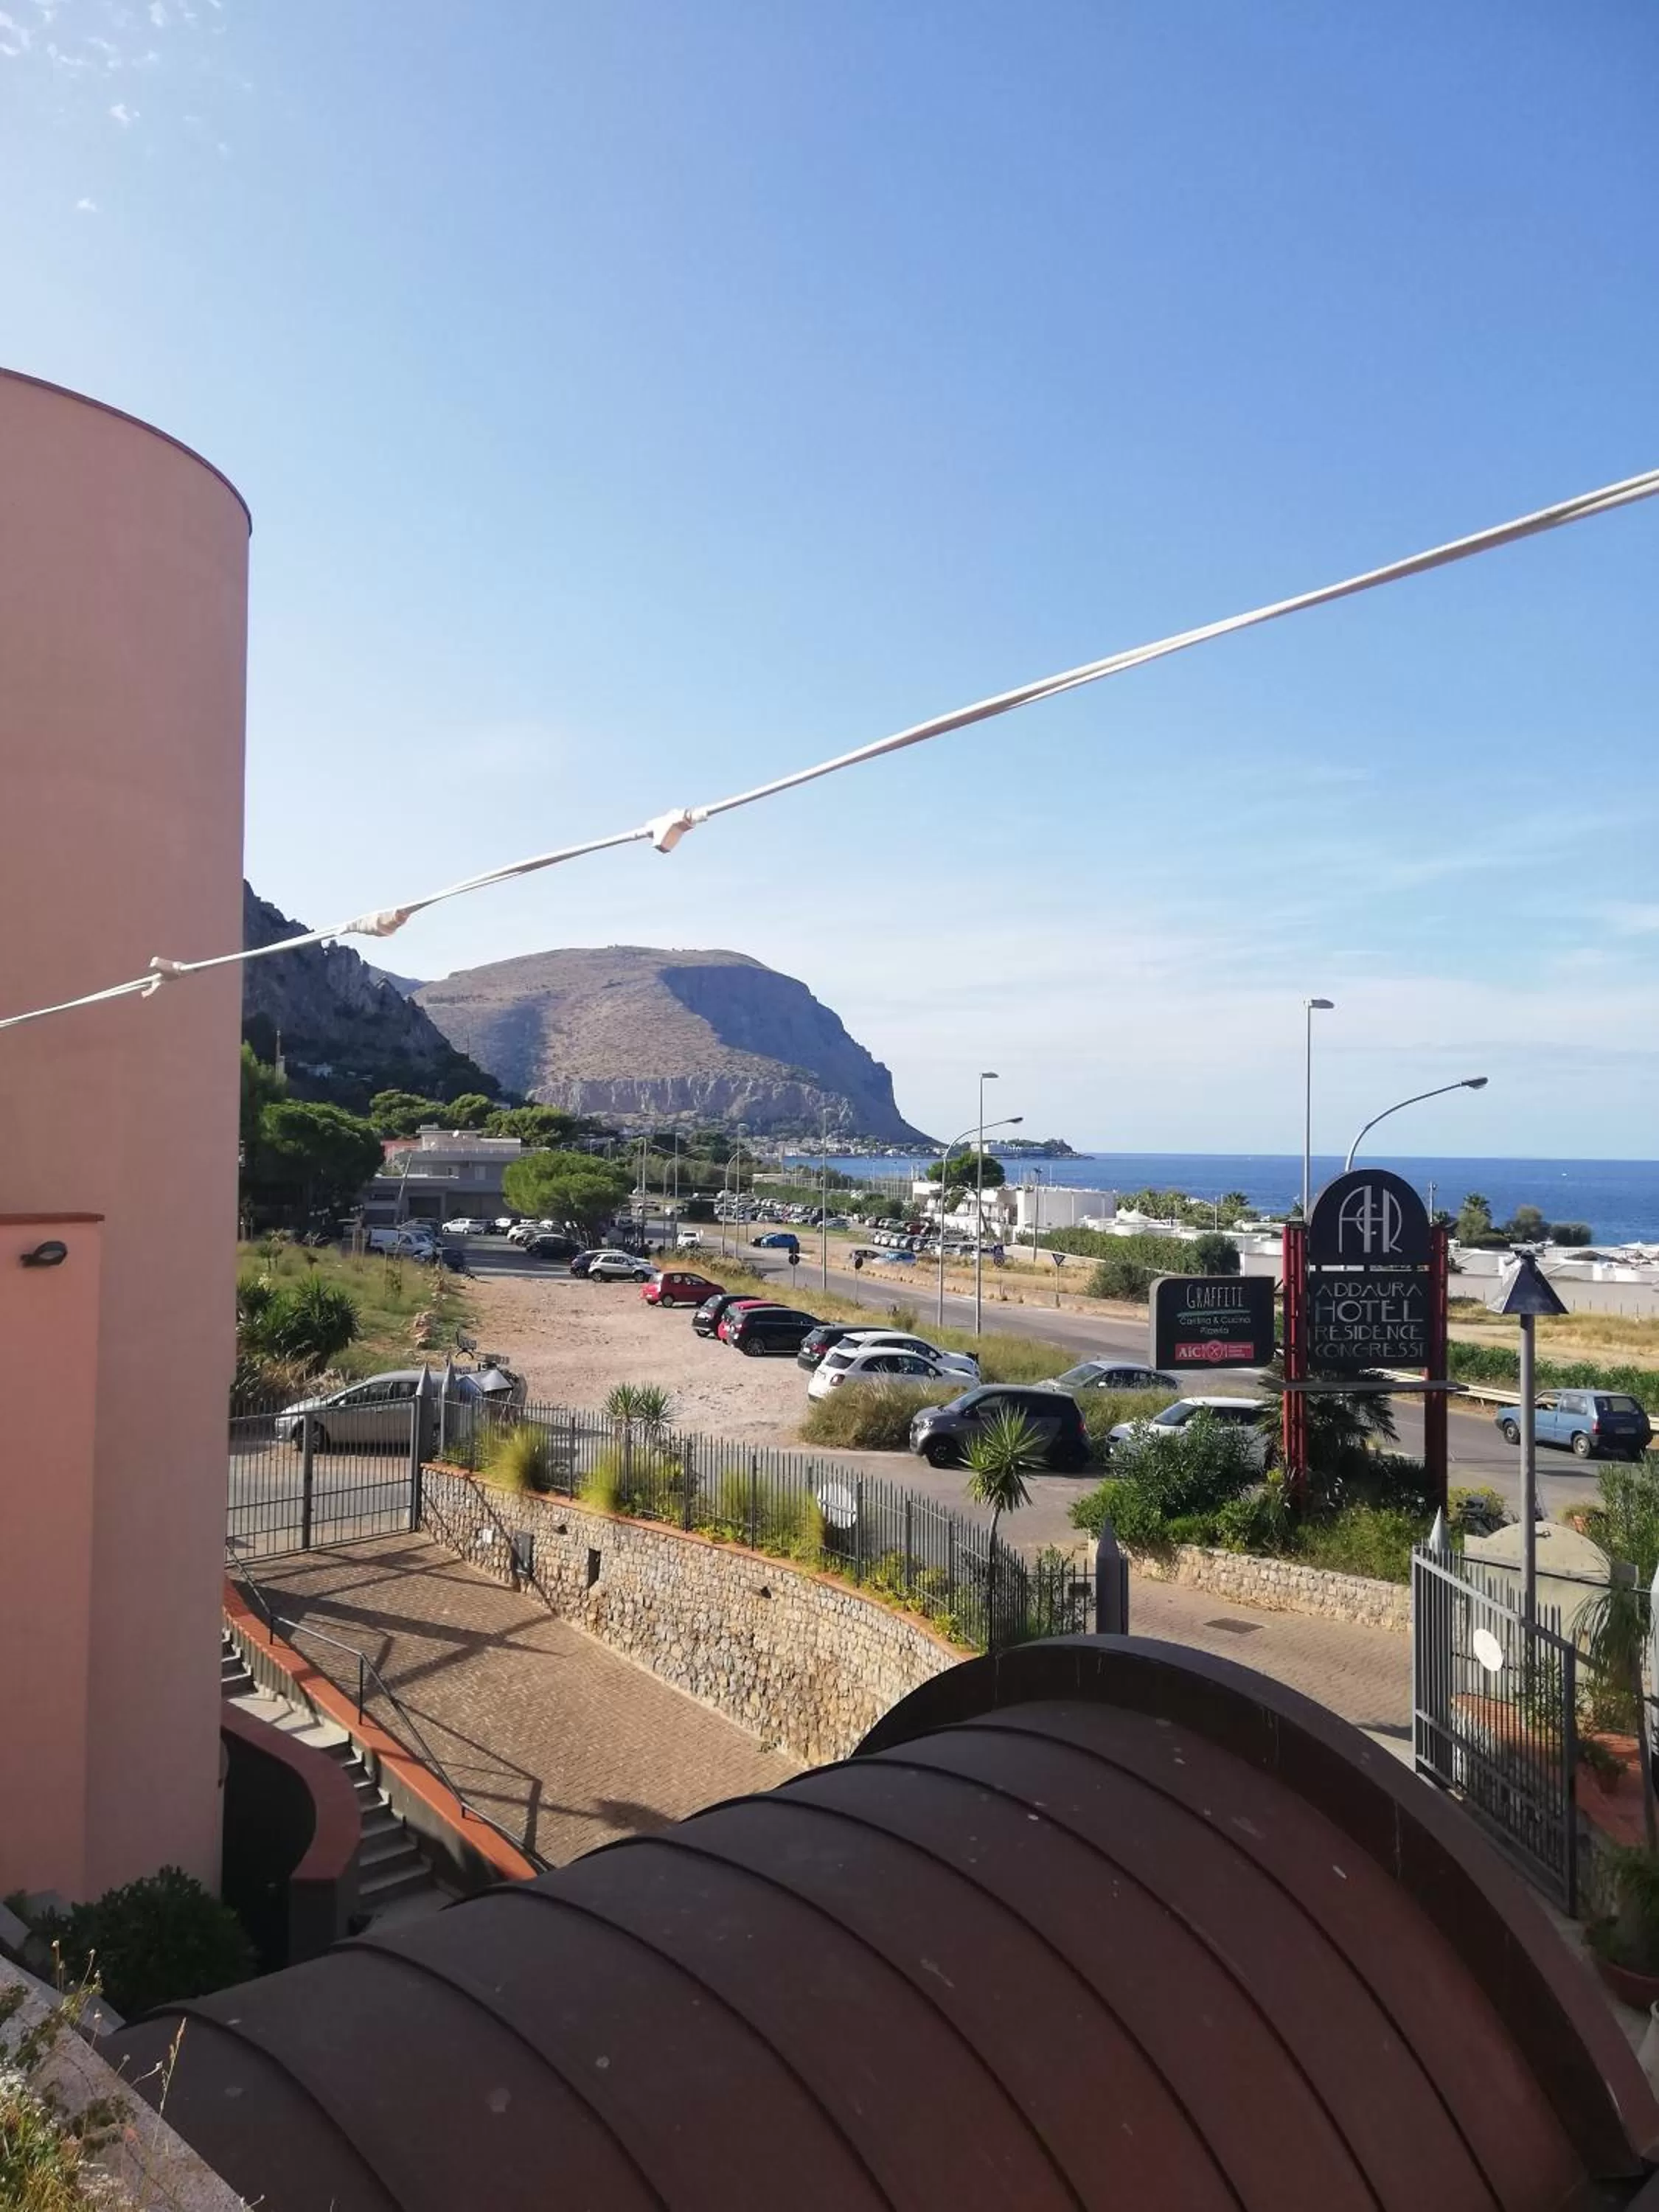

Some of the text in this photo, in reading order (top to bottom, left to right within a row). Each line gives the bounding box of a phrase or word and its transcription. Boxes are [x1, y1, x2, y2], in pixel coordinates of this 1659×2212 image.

[1315, 1281, 1423, 1298] ADDAURA
[1315, 1299, 1424, 1322] HOTEL
[1315, 1324, 1425, 1341] RESIDENCE
[1315, 1341, 1425, 1357] CONGRESSI
